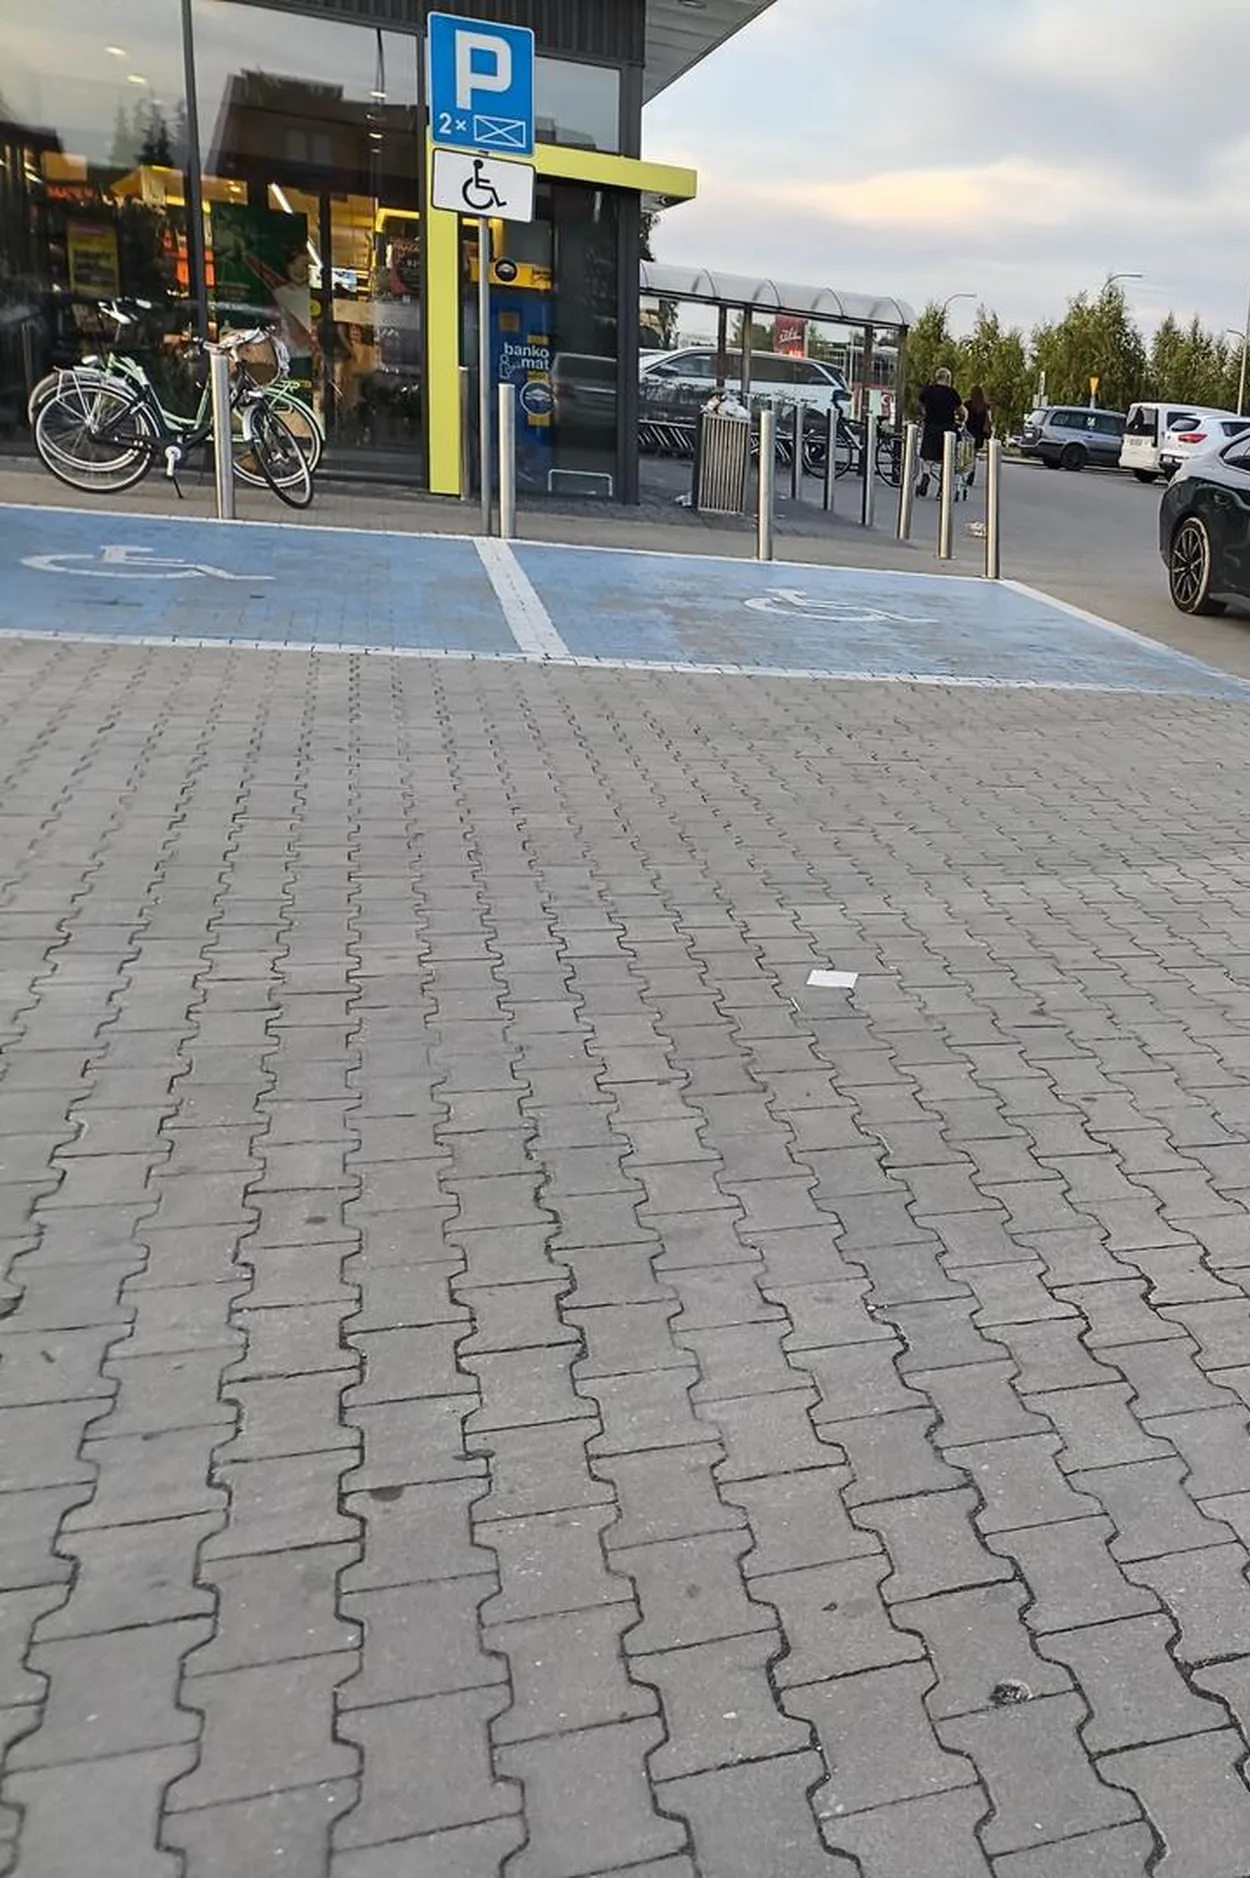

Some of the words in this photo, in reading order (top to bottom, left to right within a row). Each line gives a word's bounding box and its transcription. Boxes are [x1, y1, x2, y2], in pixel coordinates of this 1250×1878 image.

[455, 29, 512, 111] P
[504, 341, 550, 358] banko
[521, 358, 550, 370] mat
